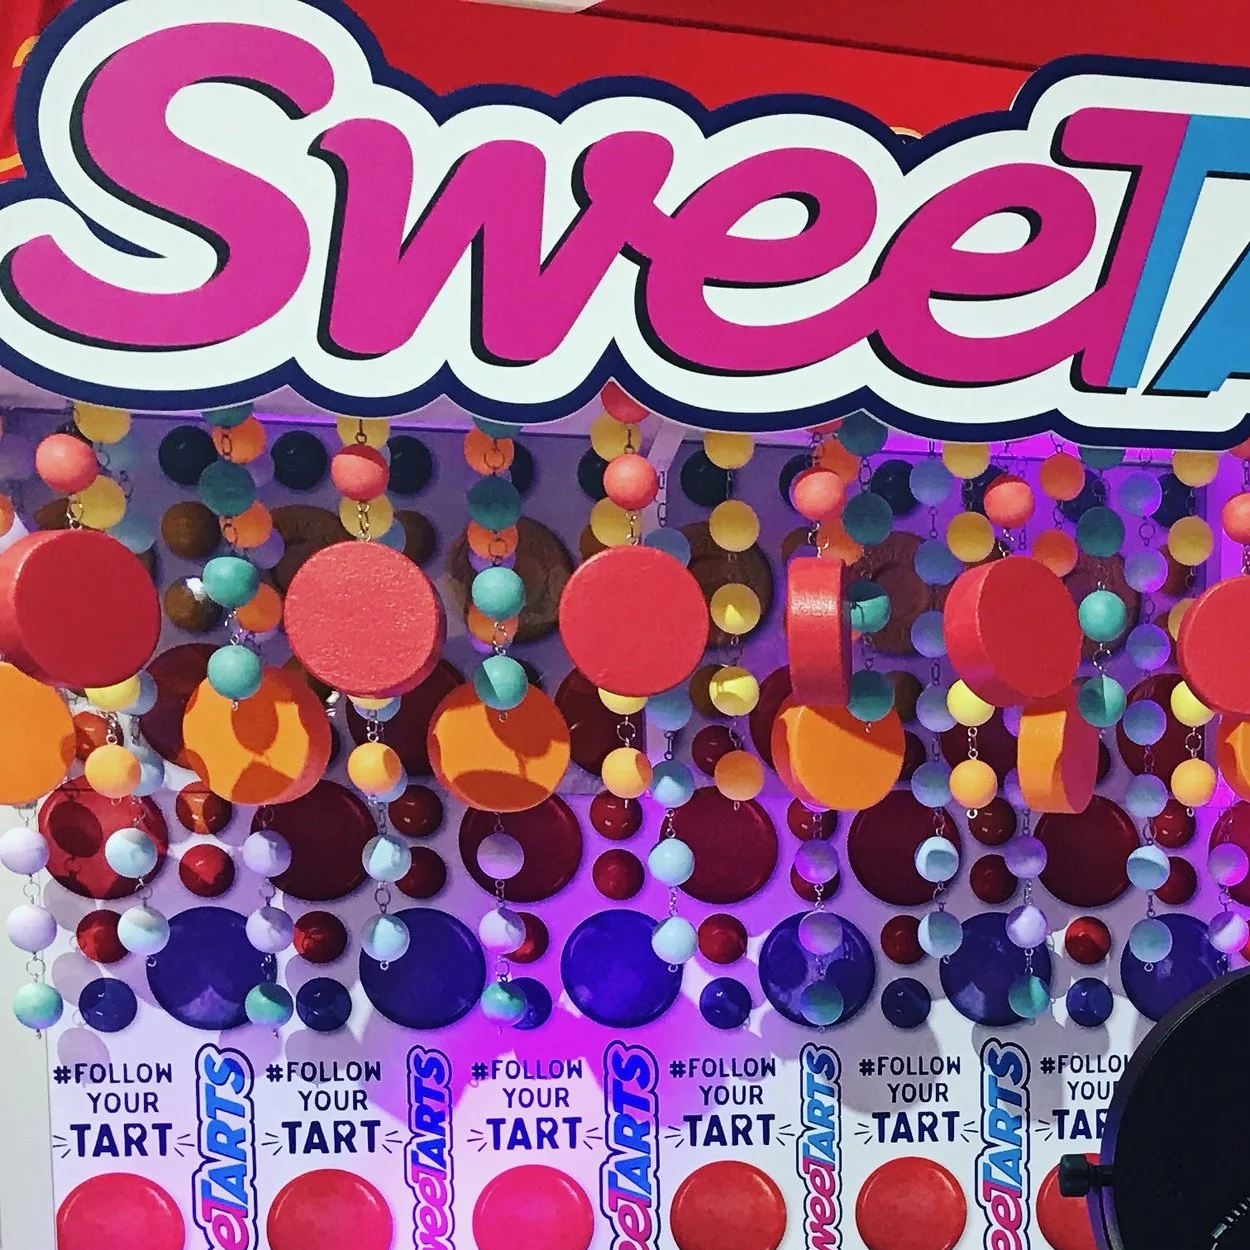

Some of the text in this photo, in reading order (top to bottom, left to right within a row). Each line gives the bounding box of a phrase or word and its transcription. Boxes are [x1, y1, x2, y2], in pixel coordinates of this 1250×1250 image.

[53, 1062, 173, 1086] #FOLLOW
[265, 1060, 382, 1083] #FOLLOW
[471, 1058, 584, 1082] #FOLLOW
[669, 1057, 777, 1078] #FOLLOW
[859, 1056, 962, 1076] #FOLLOW
[86, 1092, 159, 1114] YOUR
[299, 1089, 368, 1112] YOUR
[502, 1087, 571, 1109] YOUR
[698, 1085, 764, 1106] YOUR
[887, 1083, 949, 1103] YOUR
[280, 1119, 382, 1155] TART
[485, 1116, 583, 1151] TART
[683, 1113, 776, 1147] TART
[872, 1110, 961, 1144] TART
[70, 1123, 172, 1158] TART
